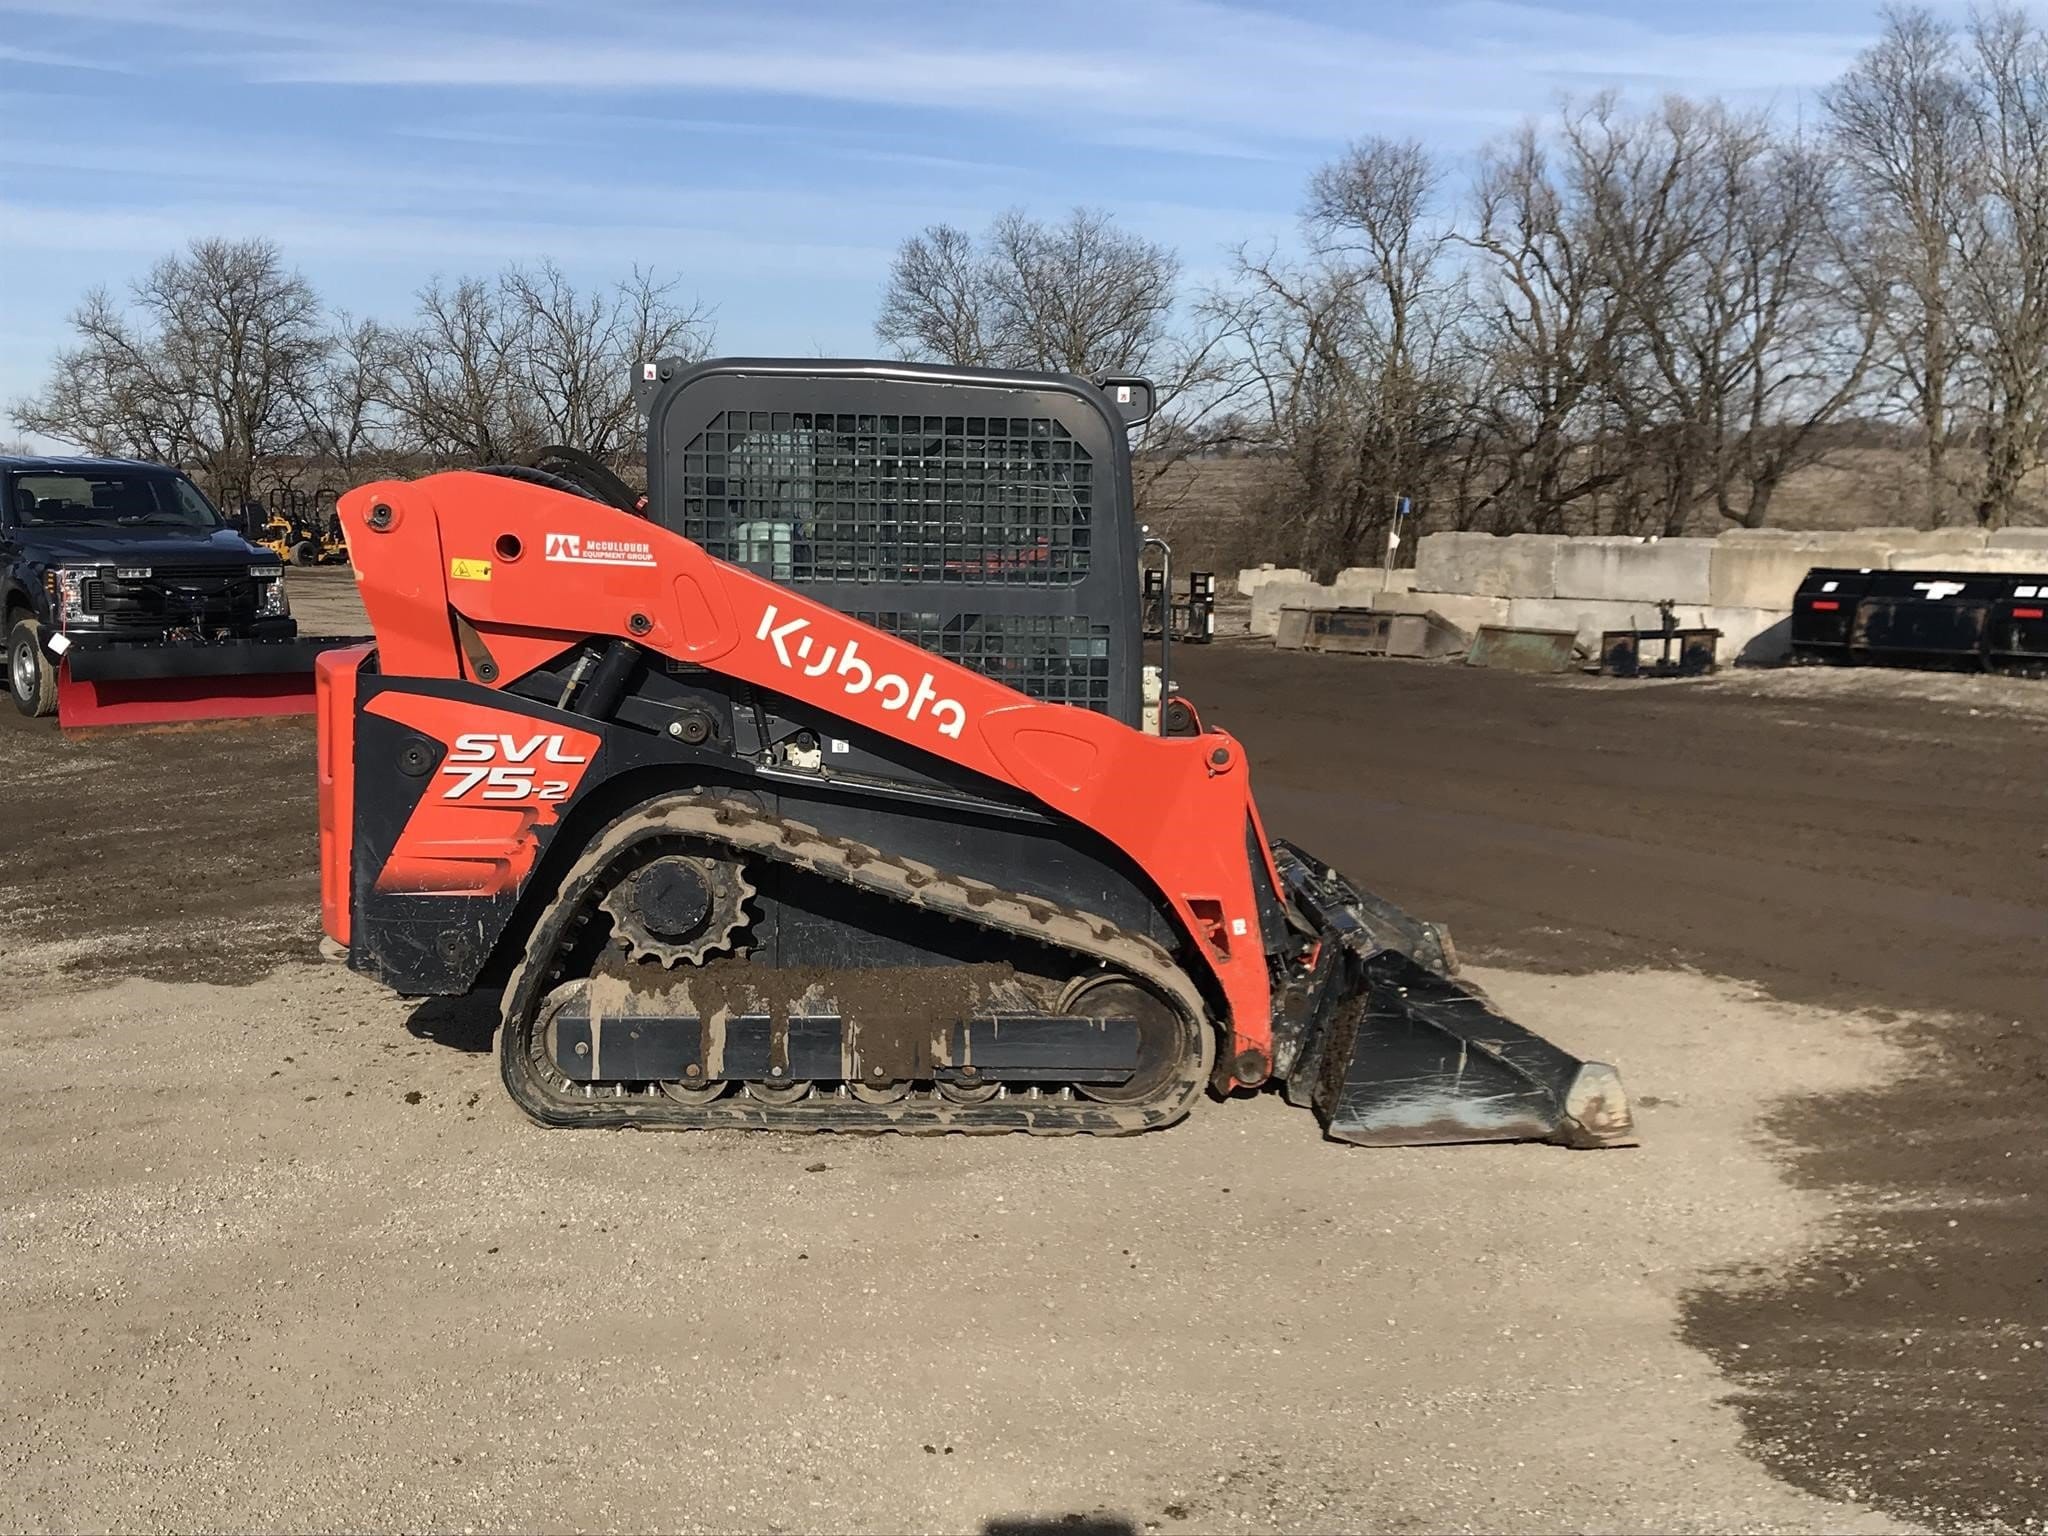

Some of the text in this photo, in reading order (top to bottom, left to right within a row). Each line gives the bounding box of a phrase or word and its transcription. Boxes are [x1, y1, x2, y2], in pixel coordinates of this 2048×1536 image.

[582, 551, 653, 561] EQUIPMENT GROUP
[586, 540, 650, 553] McCULLOUGH
[755, 604, 967, 741] Kubota
[449, 733, 586, 763] SVL
[442, 766, 569, 800] 75-2
